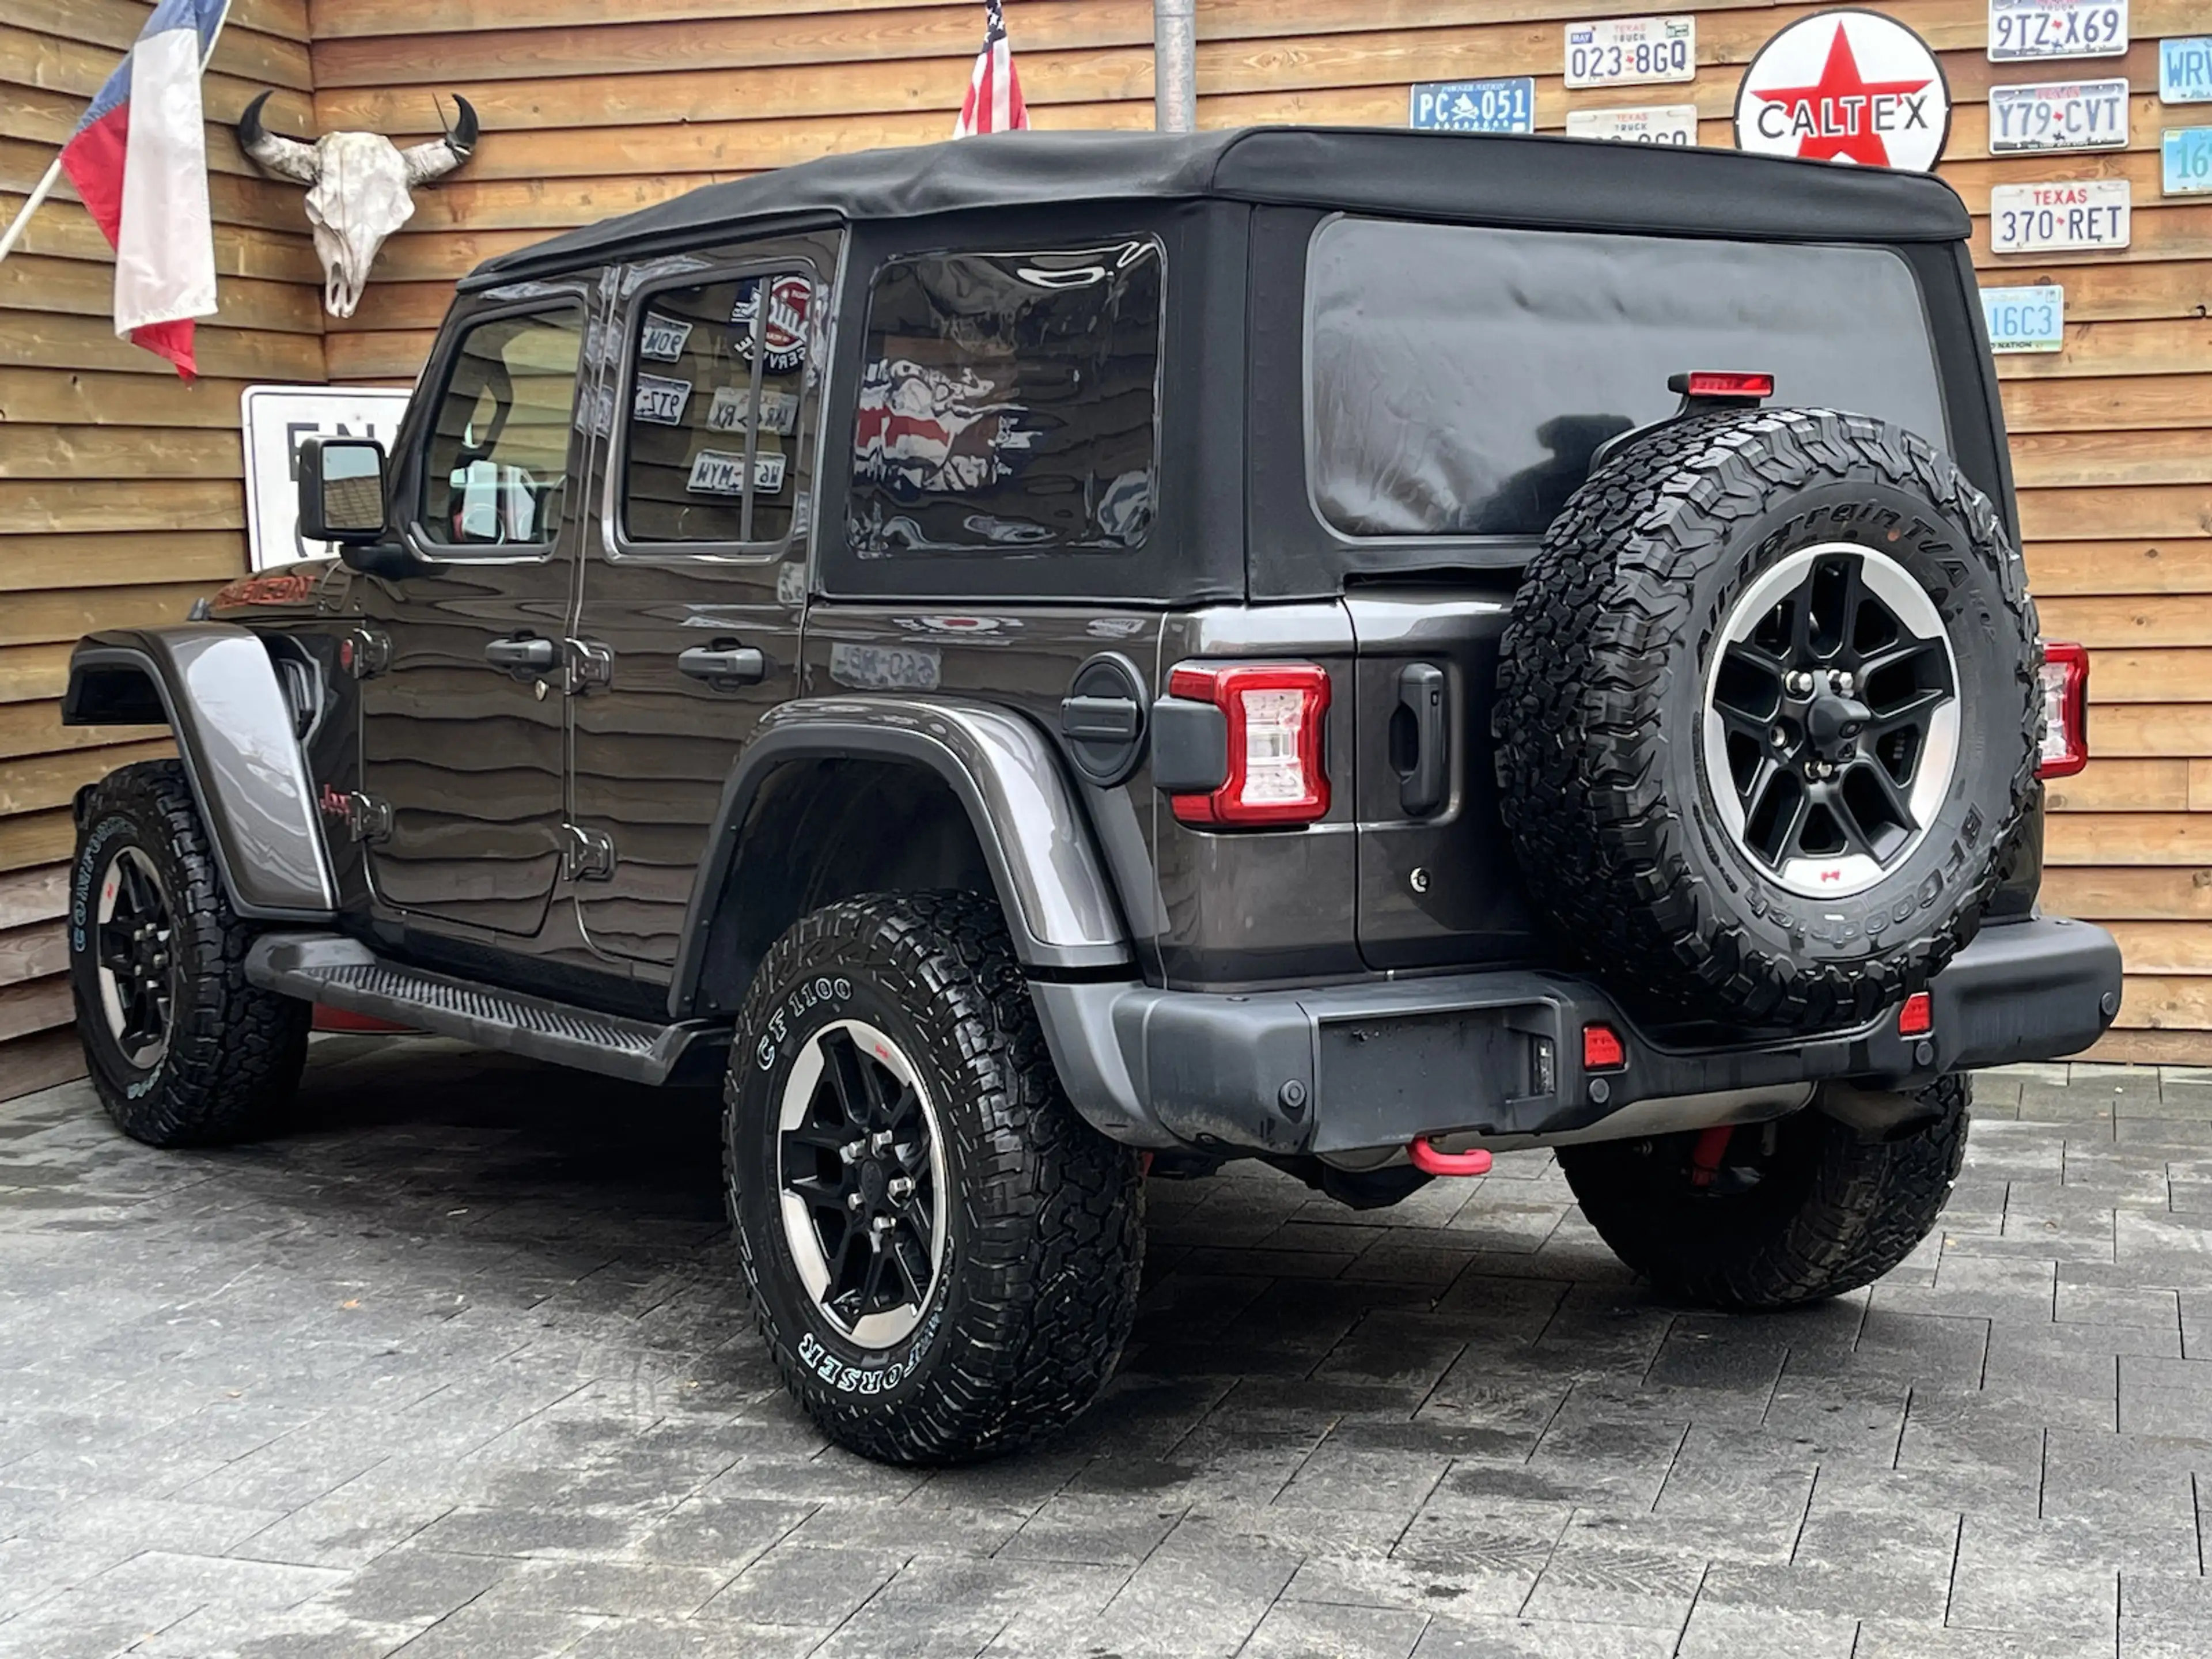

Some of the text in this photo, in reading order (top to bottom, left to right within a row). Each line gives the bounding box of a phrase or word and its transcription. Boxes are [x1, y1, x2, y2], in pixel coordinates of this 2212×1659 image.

[1613, 33, 1646, 42] TRUCK
[1419, 89, 1527, 122] PC 051
[1616, 113, 1647, 122] TEXAS
[1757, 94, 1929, 139] CALTEX
[1615, 123, 1647, 131] TRUCK
[2176, 142, 2212, 179] 16
[2033, 188, 2088, 206] TEXAS
[787, 978, 852, 1017] 1100
